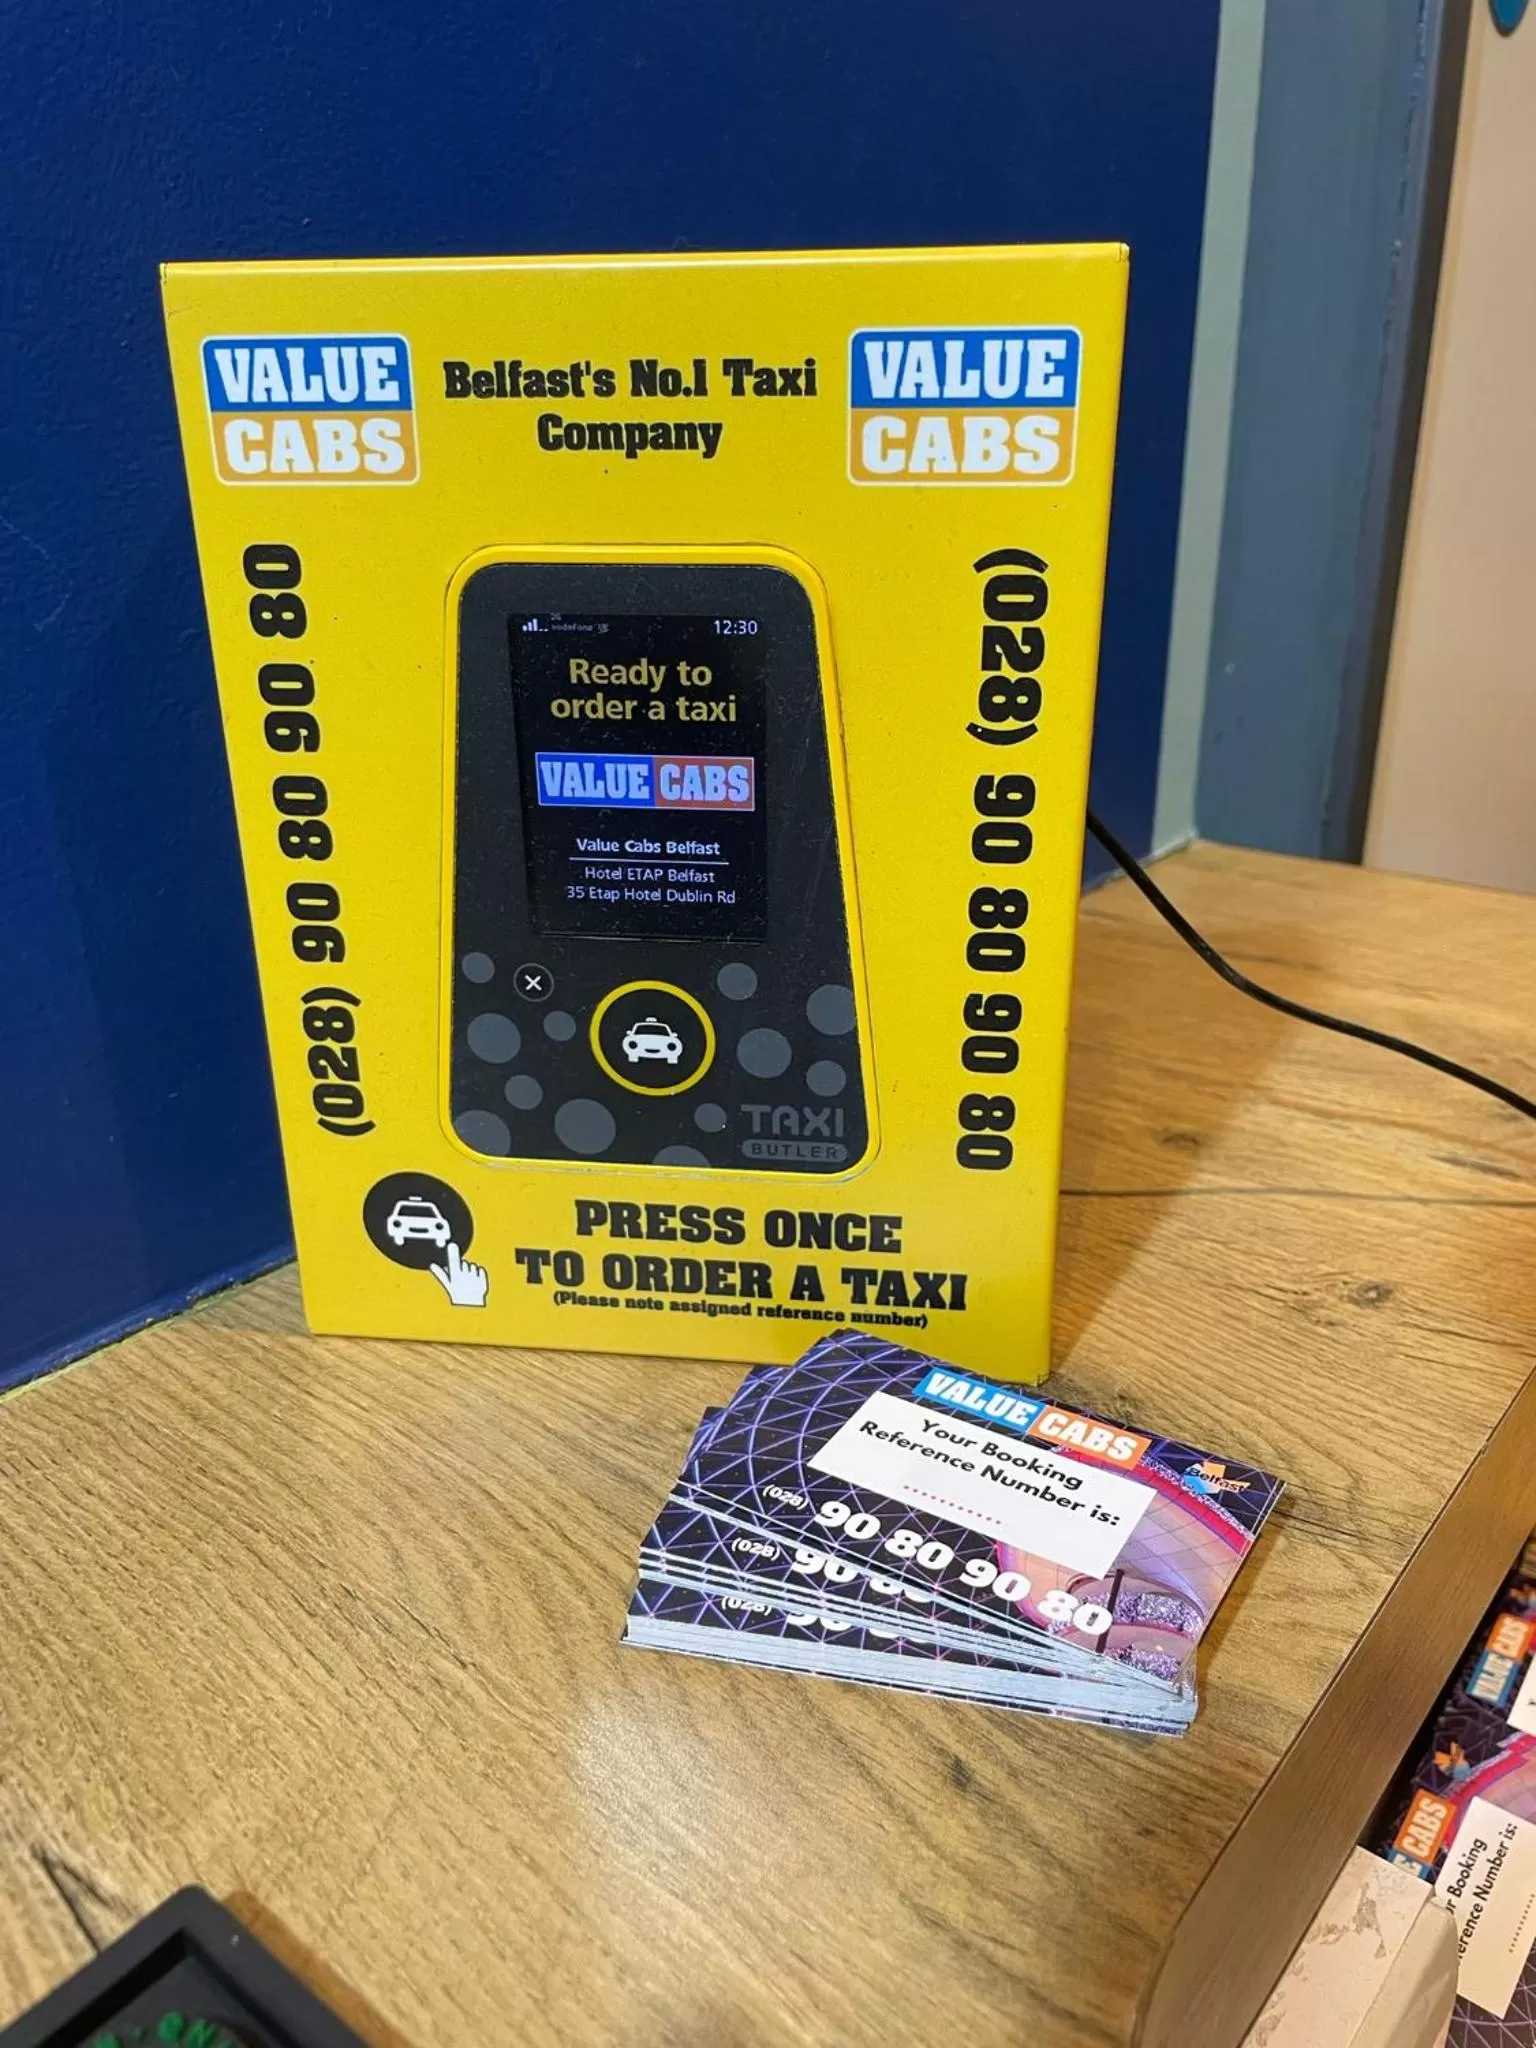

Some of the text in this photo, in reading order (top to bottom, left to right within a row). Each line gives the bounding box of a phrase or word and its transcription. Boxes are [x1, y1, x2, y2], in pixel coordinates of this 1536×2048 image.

[213, 345, 398, 403] VALUE
[443, 358, 818, 399] Belfast's No.1 Taxi
[863, 338, 1068, 399] VALUE
[223, 418, 405, 474] CABS
[538, 414, 724, 458] Company
[860, 415, 1061, 474] CABS
[713, 619, 758, 635] 12:30
[568, 657, 713, 692] Ready to
[550, 692, 738, 722] order a taxi
[540, 761, 750, 802] VALUE CABS
[242, 544, 376, 1136] (028) 90 80 90 80
[576, 837, 720, 855] Value Cabs Belfast
[955, 548, 1049, 1171] (028) 90 80 90 80
[567, 885, 736, 904] 35 Etap Hotel Dublin Rd
[585, 866, 715, 883] Hotel ETAP Belfast
[740, 1104, 844, 1138] TAXI
[751, 1142, 839, 1159] BUTLER
[575, 1199, 902, 1253] PRESS ONCE
[515, 1248, 968, 1311] TO ORDER A TAXI
[553, 1290, 928, 1329] (Please note assigned reference number)
[925, 1373, 1140, 1463] VALUE CABS
[859, 1420, 1122, 1527] Reference Number is:
[922, 1418, 1084, 1492] Your Booking
[731, 1537, 781, 1561] (028)
[762, 1484, 810, 1511] (028)
[814, 1501, 881, 1540] 90
[884, 1528, 955, 1570] 80
[959, 1558, 1032, 1602] 90
[1036, 1589, 1114, 1636] 80
[1402, 1797, 1448, 1857] CABS
[1446, 1838, 1488, 1899] Booking
[1457, 1822, 1518, 1960] erence Number is:
